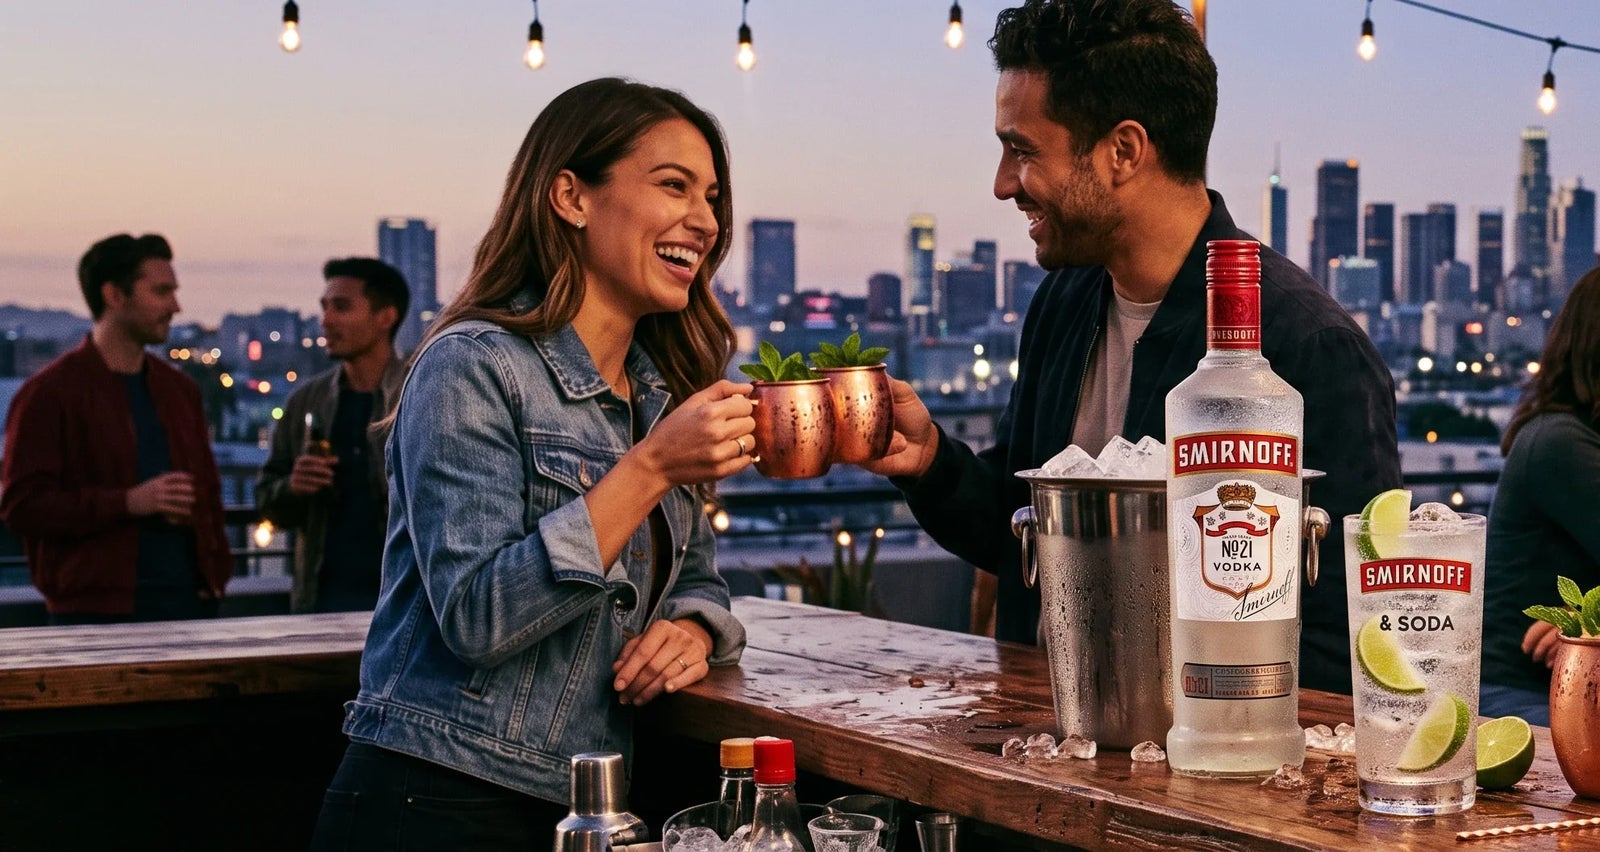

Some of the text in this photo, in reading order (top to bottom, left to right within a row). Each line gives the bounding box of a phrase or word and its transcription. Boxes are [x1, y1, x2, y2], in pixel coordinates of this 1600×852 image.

[1179, 440, 1292, 467] SMIRNOFF
[1213, 562, 1262, 572] VODKA
[1366, 564, 1465, 586] SMIRNOFF
[1380, 614, 1455, 631] & SODA
